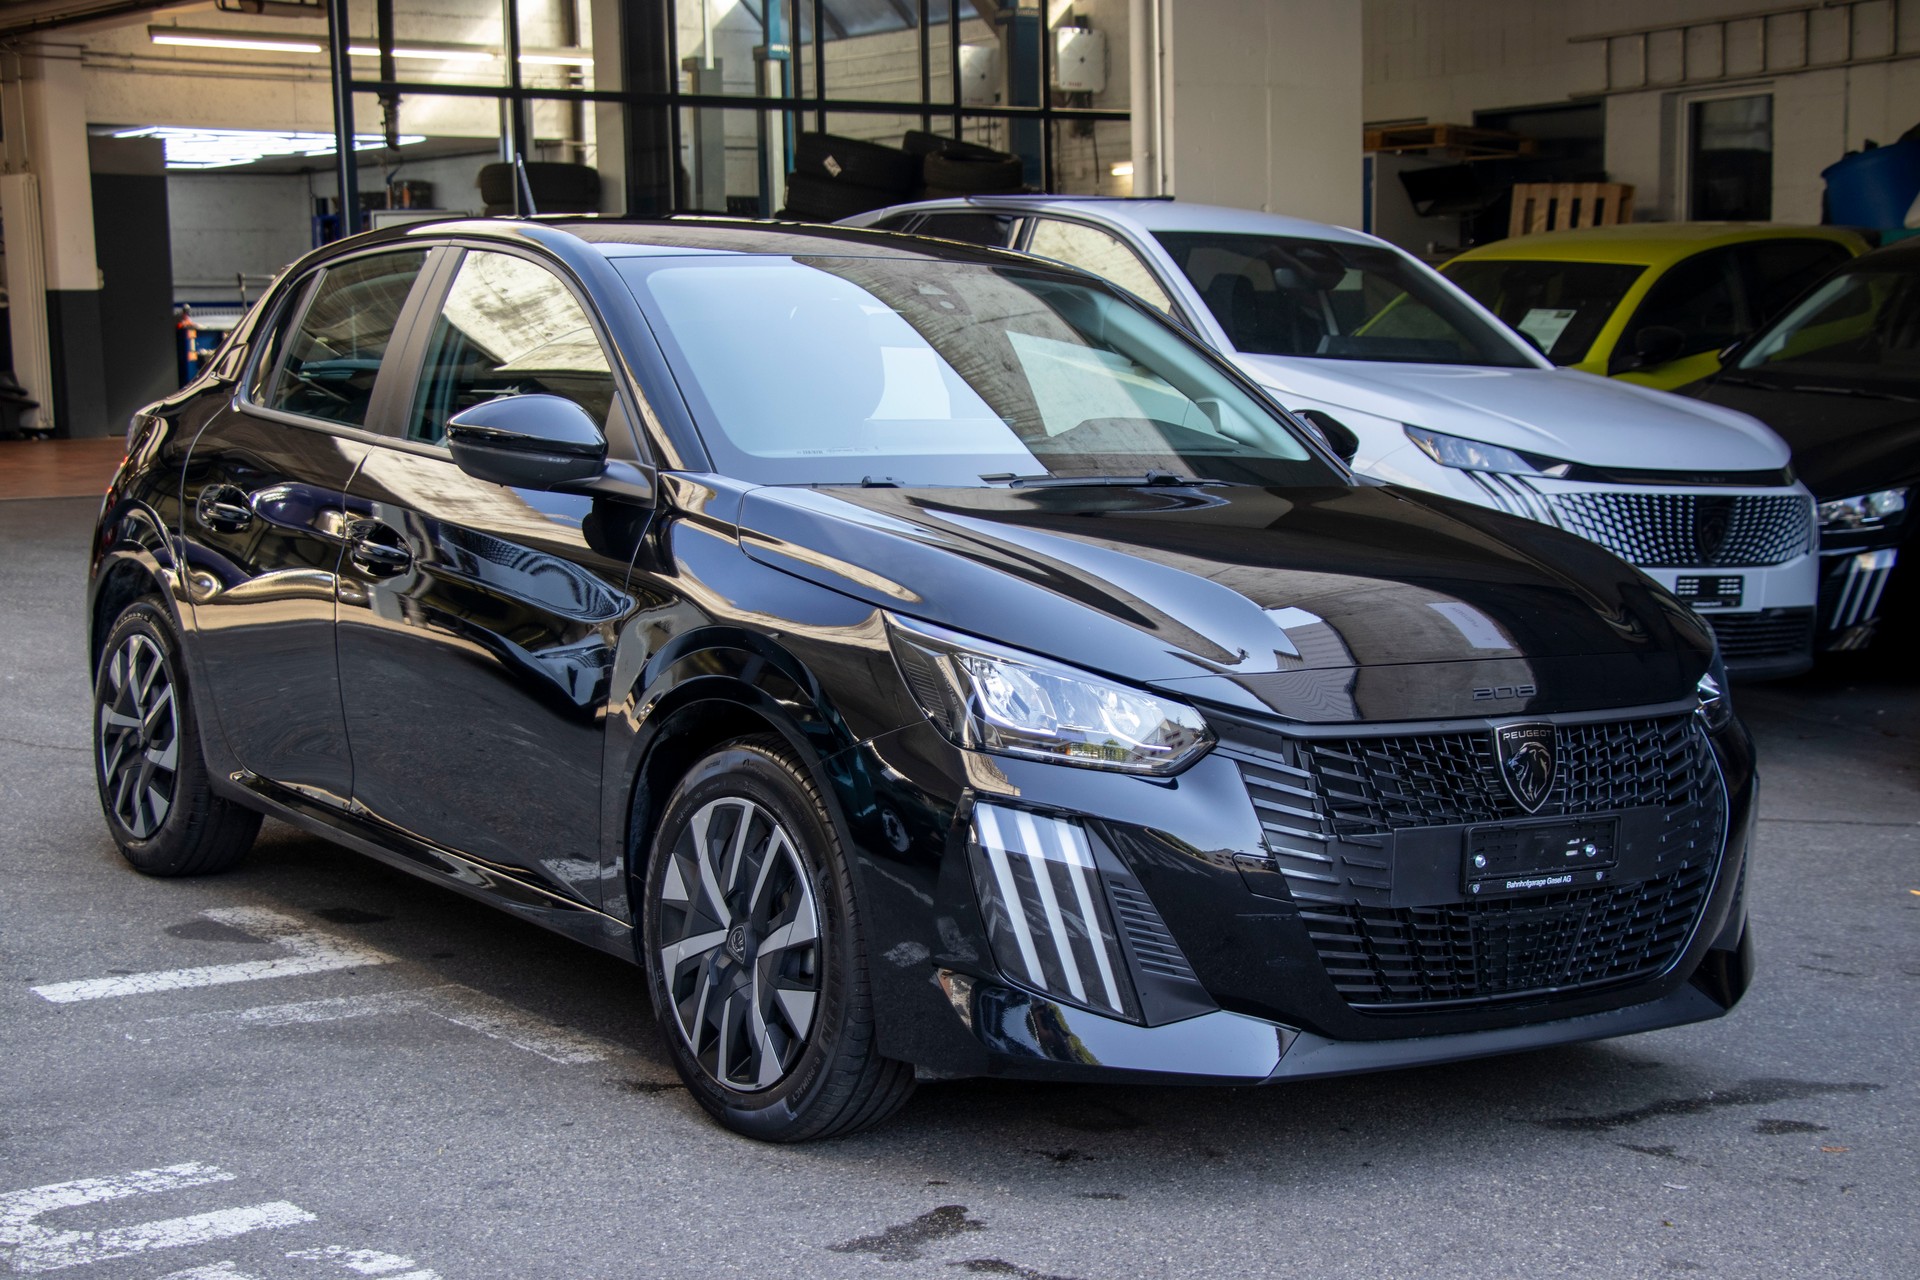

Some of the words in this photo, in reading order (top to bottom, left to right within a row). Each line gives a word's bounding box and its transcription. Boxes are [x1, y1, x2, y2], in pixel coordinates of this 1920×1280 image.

[1473, 684, 1537, 701] 208
[1503, 729, 1552, 741] PEUGEOT
[1506, 879, 1546, 888] Bahnhofgarage
[1563, 875, 1571, 883] AG
